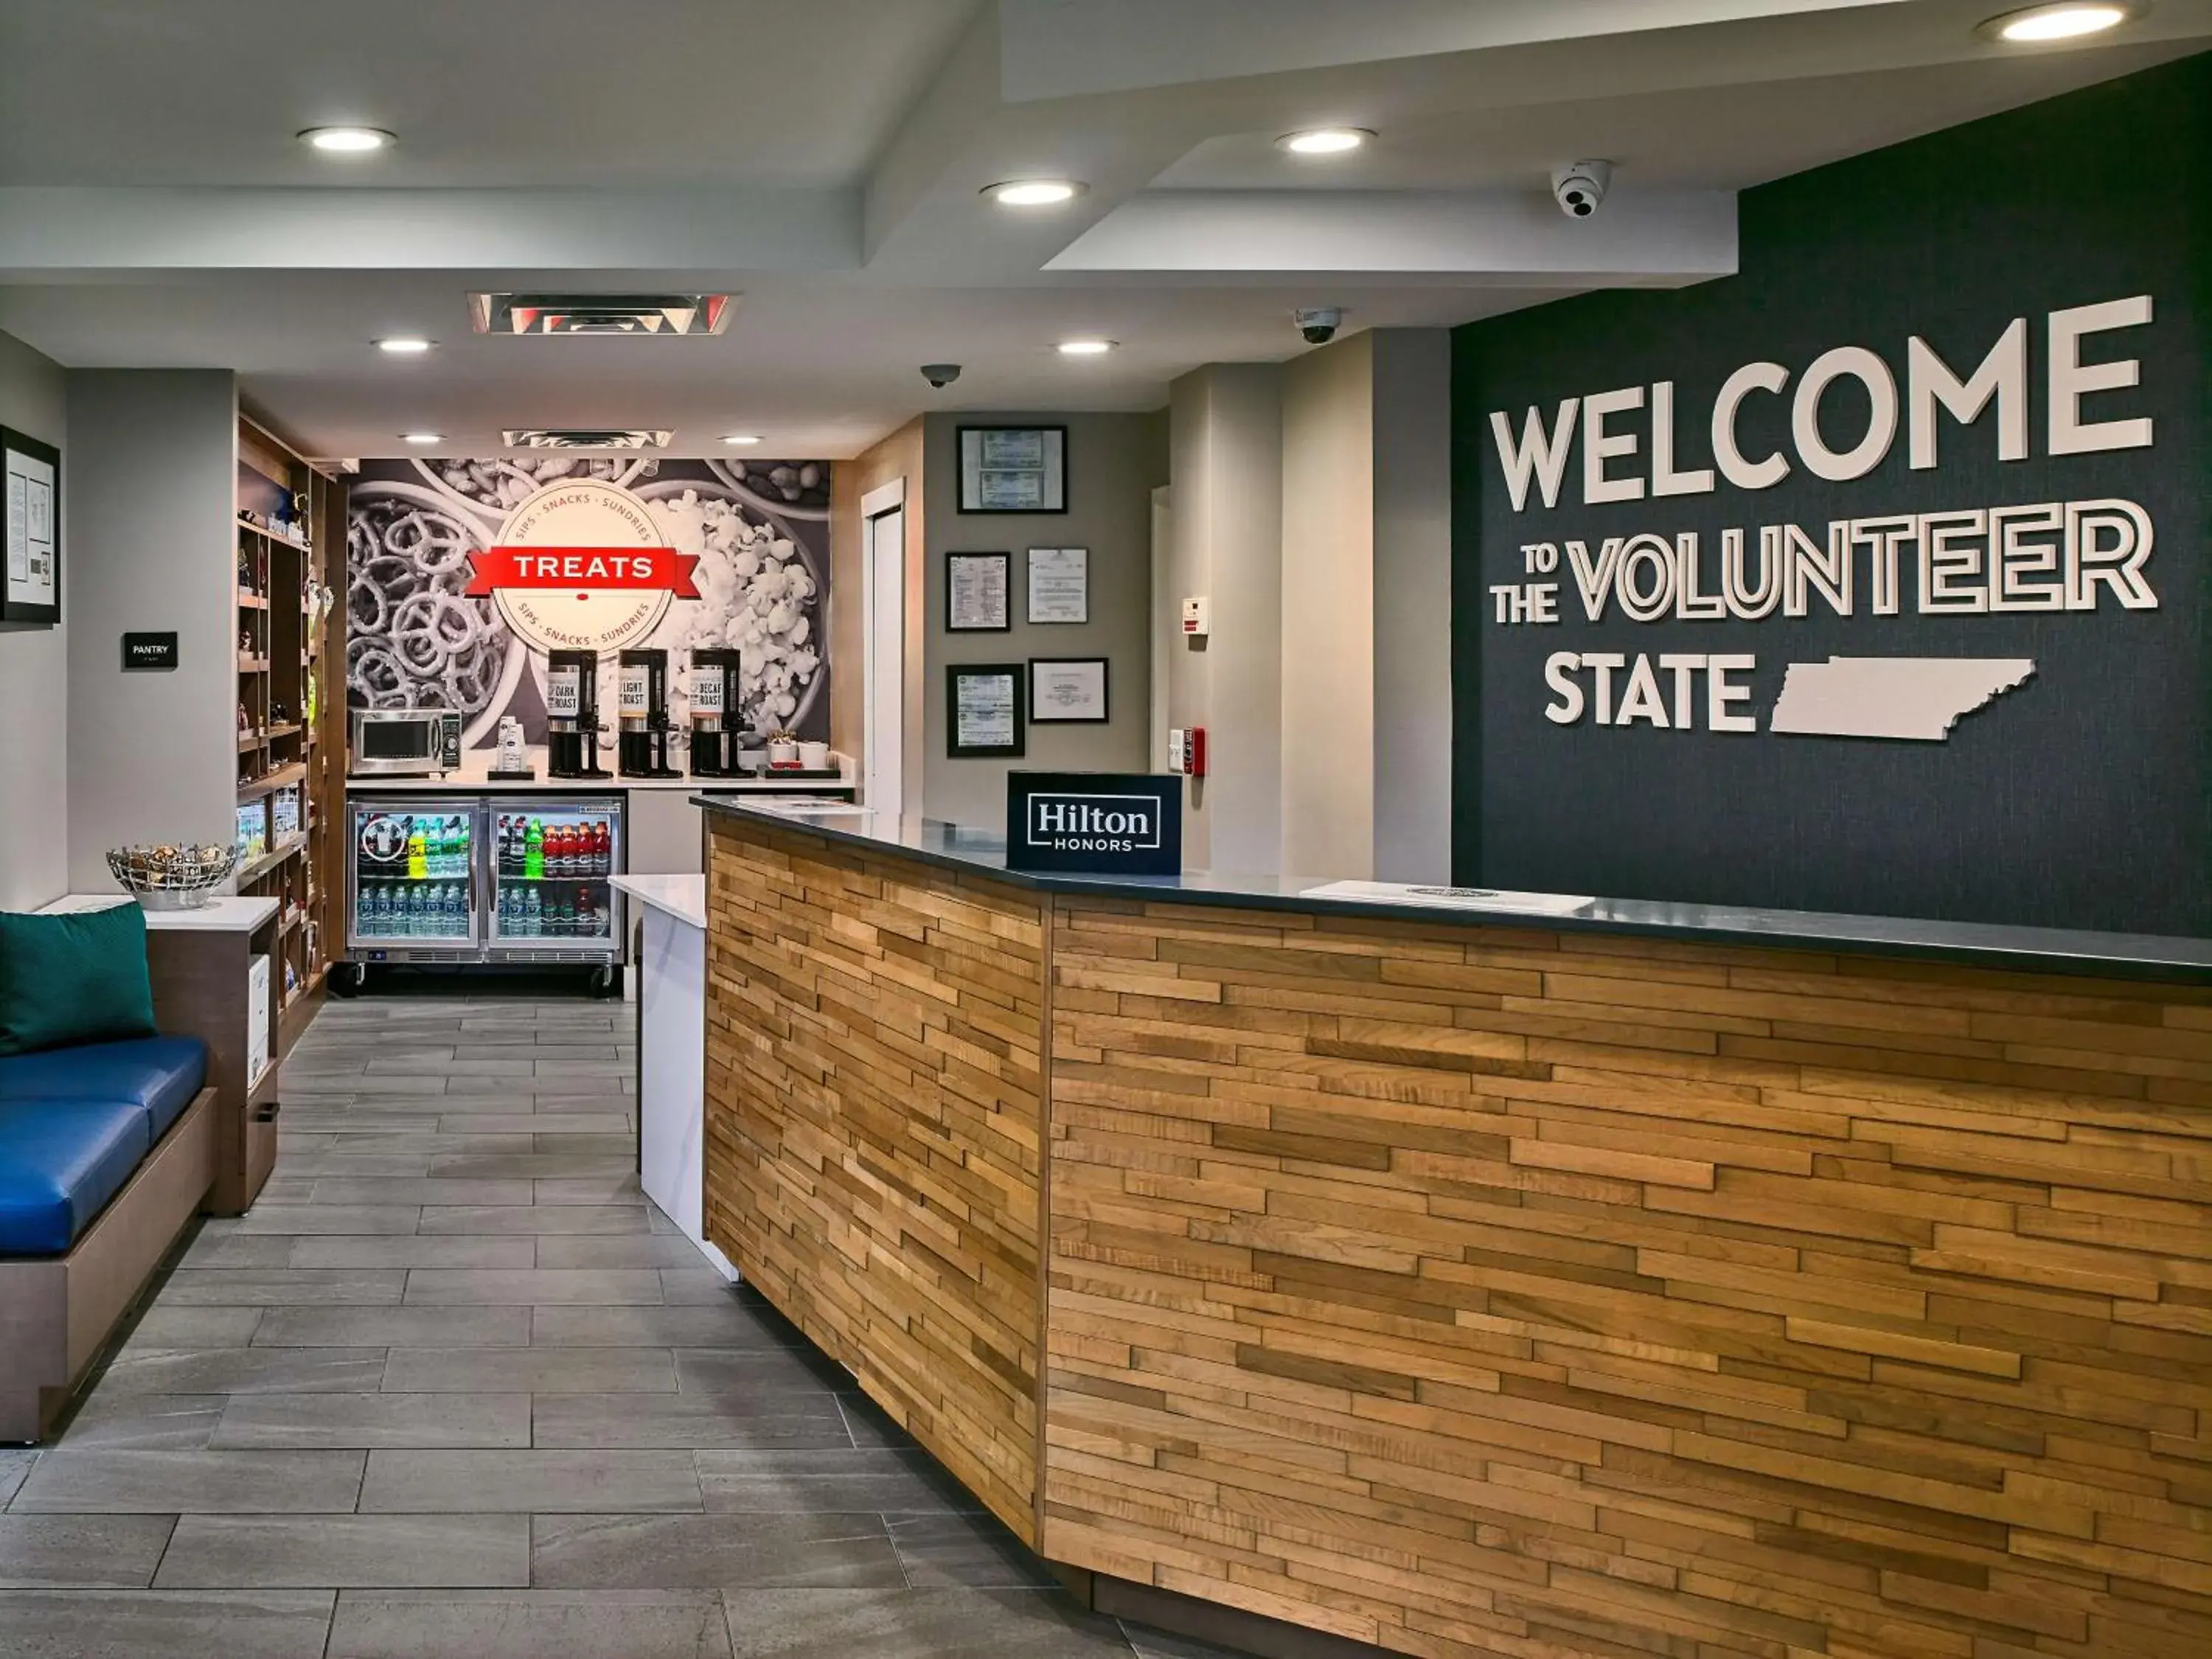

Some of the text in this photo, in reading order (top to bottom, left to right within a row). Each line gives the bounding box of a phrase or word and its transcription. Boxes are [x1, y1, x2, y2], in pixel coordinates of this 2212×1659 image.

[1489, 295, 2152, 512] WELCOME
[516, 494, 650, 541] SIPS SNACKS SUNDRIES
[513, 556, 653, 578] TREATS
[1489, 498, 2158, 624] TO THE VOLUNTEER
[518, 602, 649, 645] SIPS SNACKS SUNDRIES
[133, 645, 168, 654] PANTRY
[555, 686, 576, 697] DARK
[623, 682, 643, 692] LIGHT
[700, 683, 721, 694] DECAF
[1545, 651, 1756, 732] STATE
[555, 697, 577, 709] ROAST
[623, 694, 644, 704] ROAST
[700, 695, 721, 706] ROAST
[1038, 804, 1150, 834] Hilton
[1054, 838, 1132, 852] HONORS
